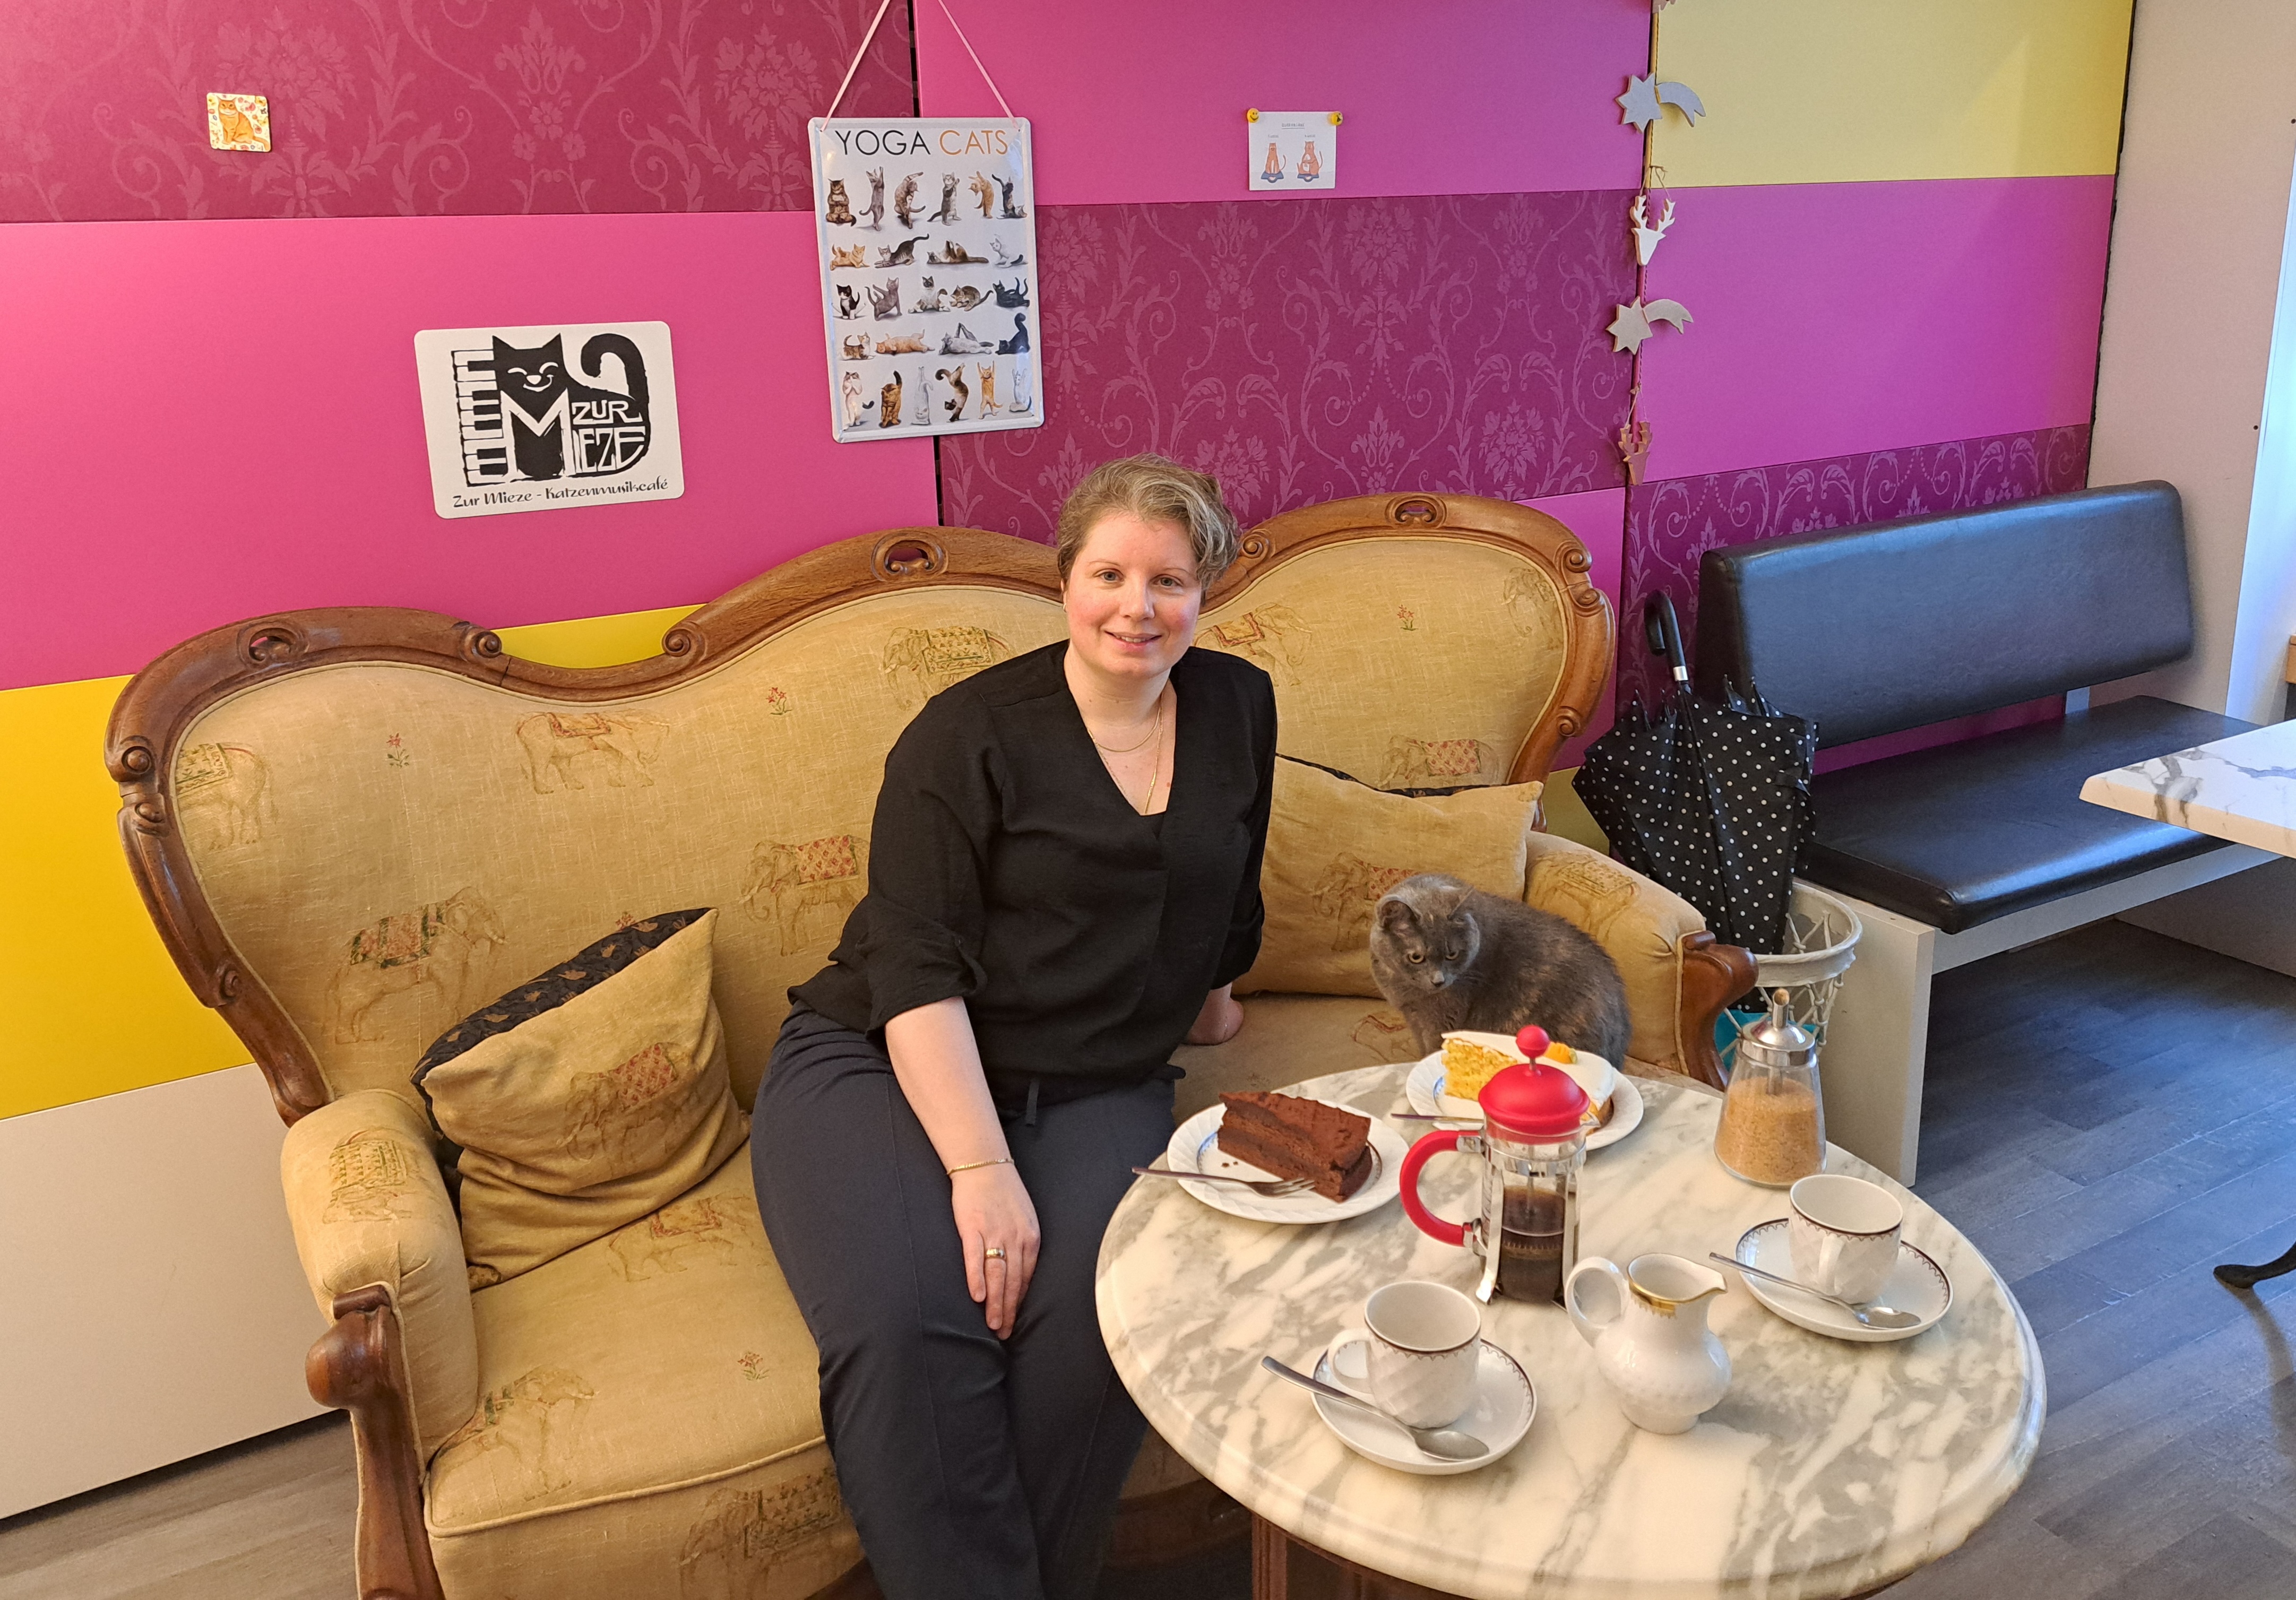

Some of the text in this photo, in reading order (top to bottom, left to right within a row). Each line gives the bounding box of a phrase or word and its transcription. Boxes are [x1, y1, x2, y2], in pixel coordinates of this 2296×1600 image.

[834, 129, 1008, 156] YOGA CATS
[572, 400, 643, 425] ZUR
[452, 494, 480, 508] Zur
[484, 491, 532, 505] Mieze
[545, 475, 669, 500] Katzenmusikcafé
